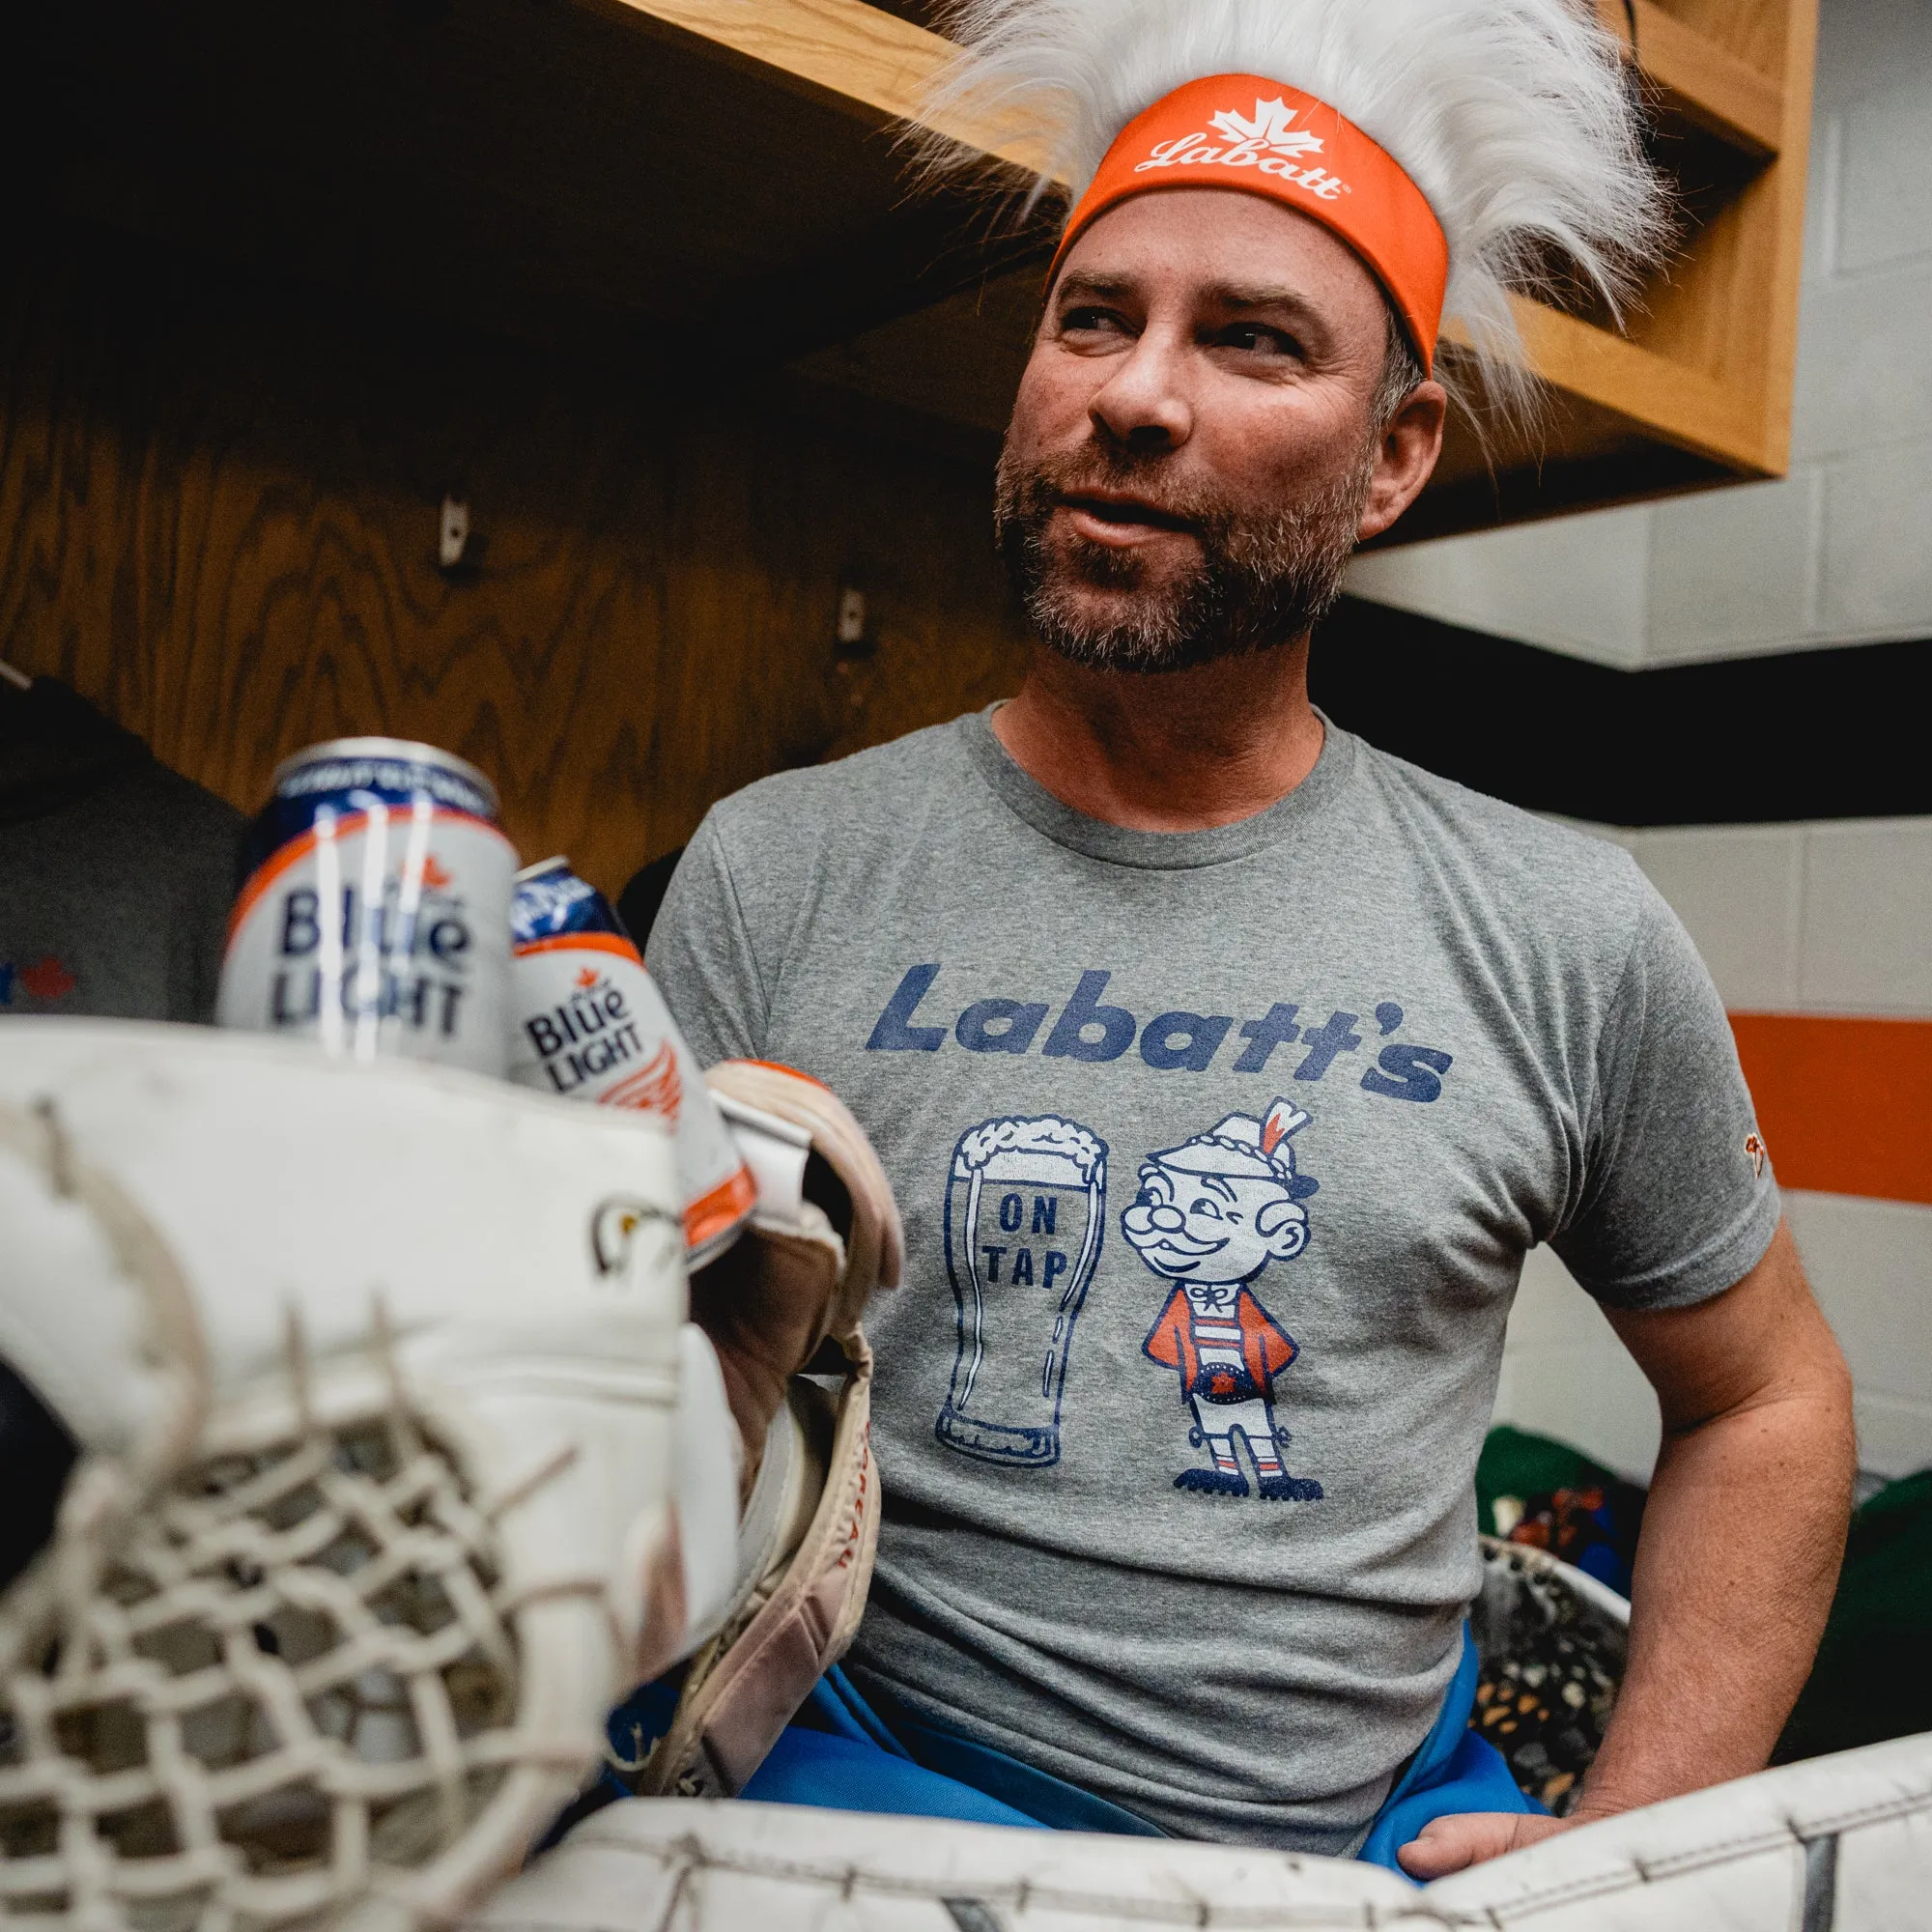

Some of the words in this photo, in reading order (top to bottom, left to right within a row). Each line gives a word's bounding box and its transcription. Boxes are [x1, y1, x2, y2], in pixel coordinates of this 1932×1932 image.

[1134, 131, 1342, 201] Labatt
[279, 884, 472, 971] Blue
[526, 989, 631, 1058] Blue
[547, 1021, 643, 1094] LIGHT
[865, 963, 1454, 1104] Labatt's
[999, 1192, 1058, 1236] ON
[981, 1245, 1067, 1289] TAP
